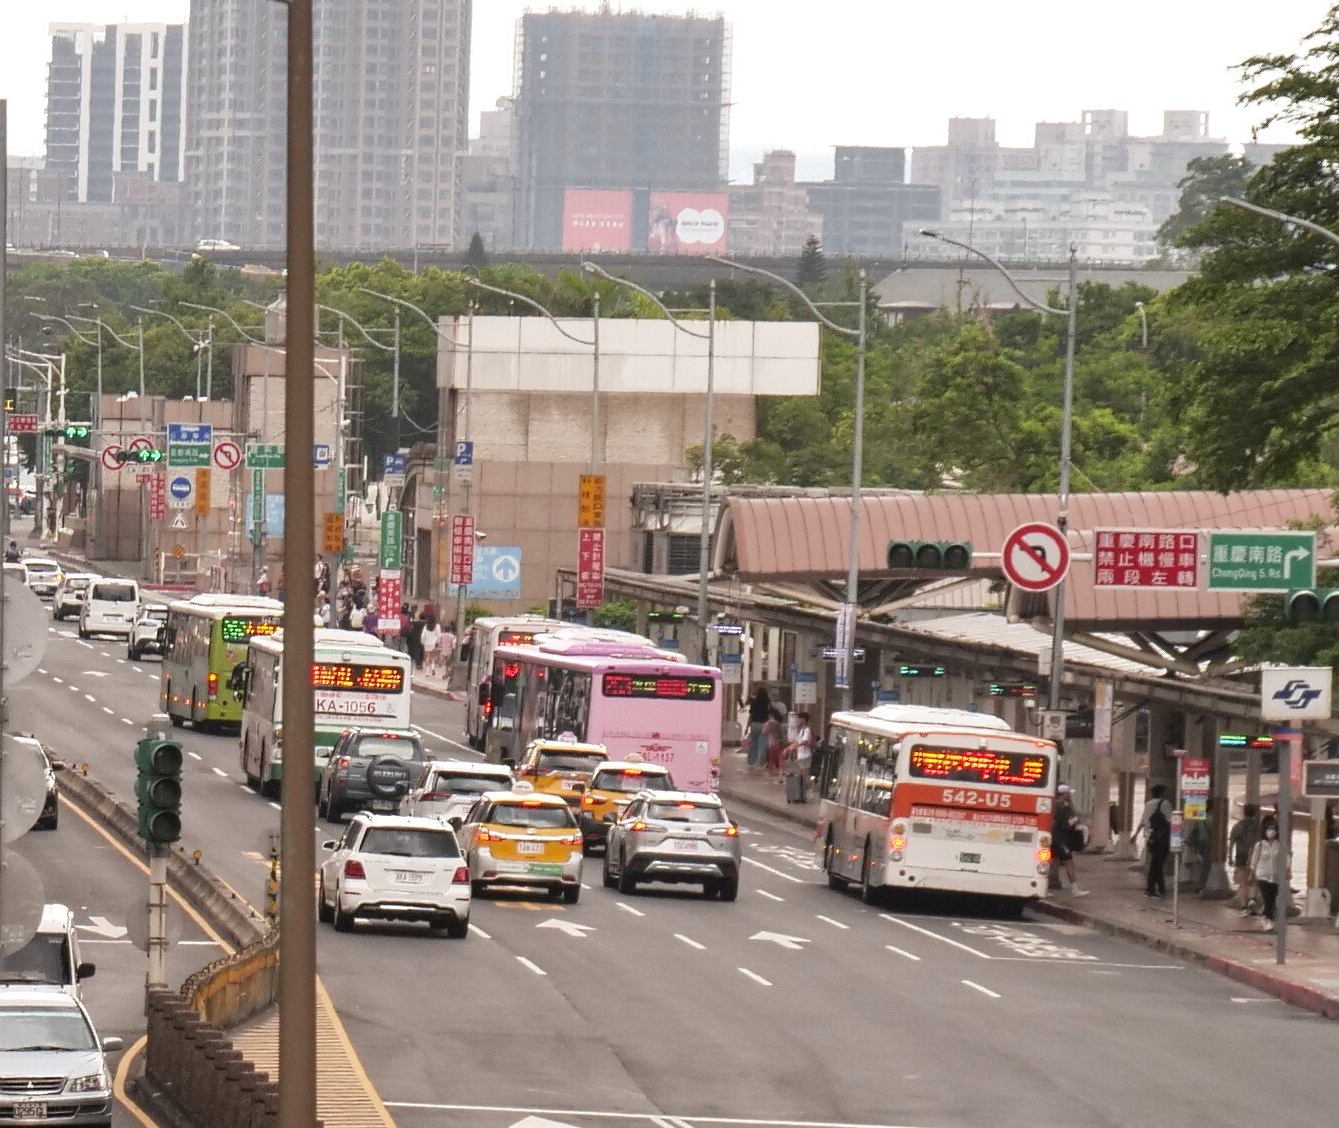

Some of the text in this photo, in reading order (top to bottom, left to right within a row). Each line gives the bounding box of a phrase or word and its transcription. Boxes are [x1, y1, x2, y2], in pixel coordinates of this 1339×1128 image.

[1098, 533, 1196, 549] 重慶南路口
[1098, 551, 1195, 567] 禁止機慢車
[1212, 545, 1282, 564] 重慶南路
[1097, 569, 1195, 585] 兩段左轉
[941, 789, 1012, 809] 542-U5
